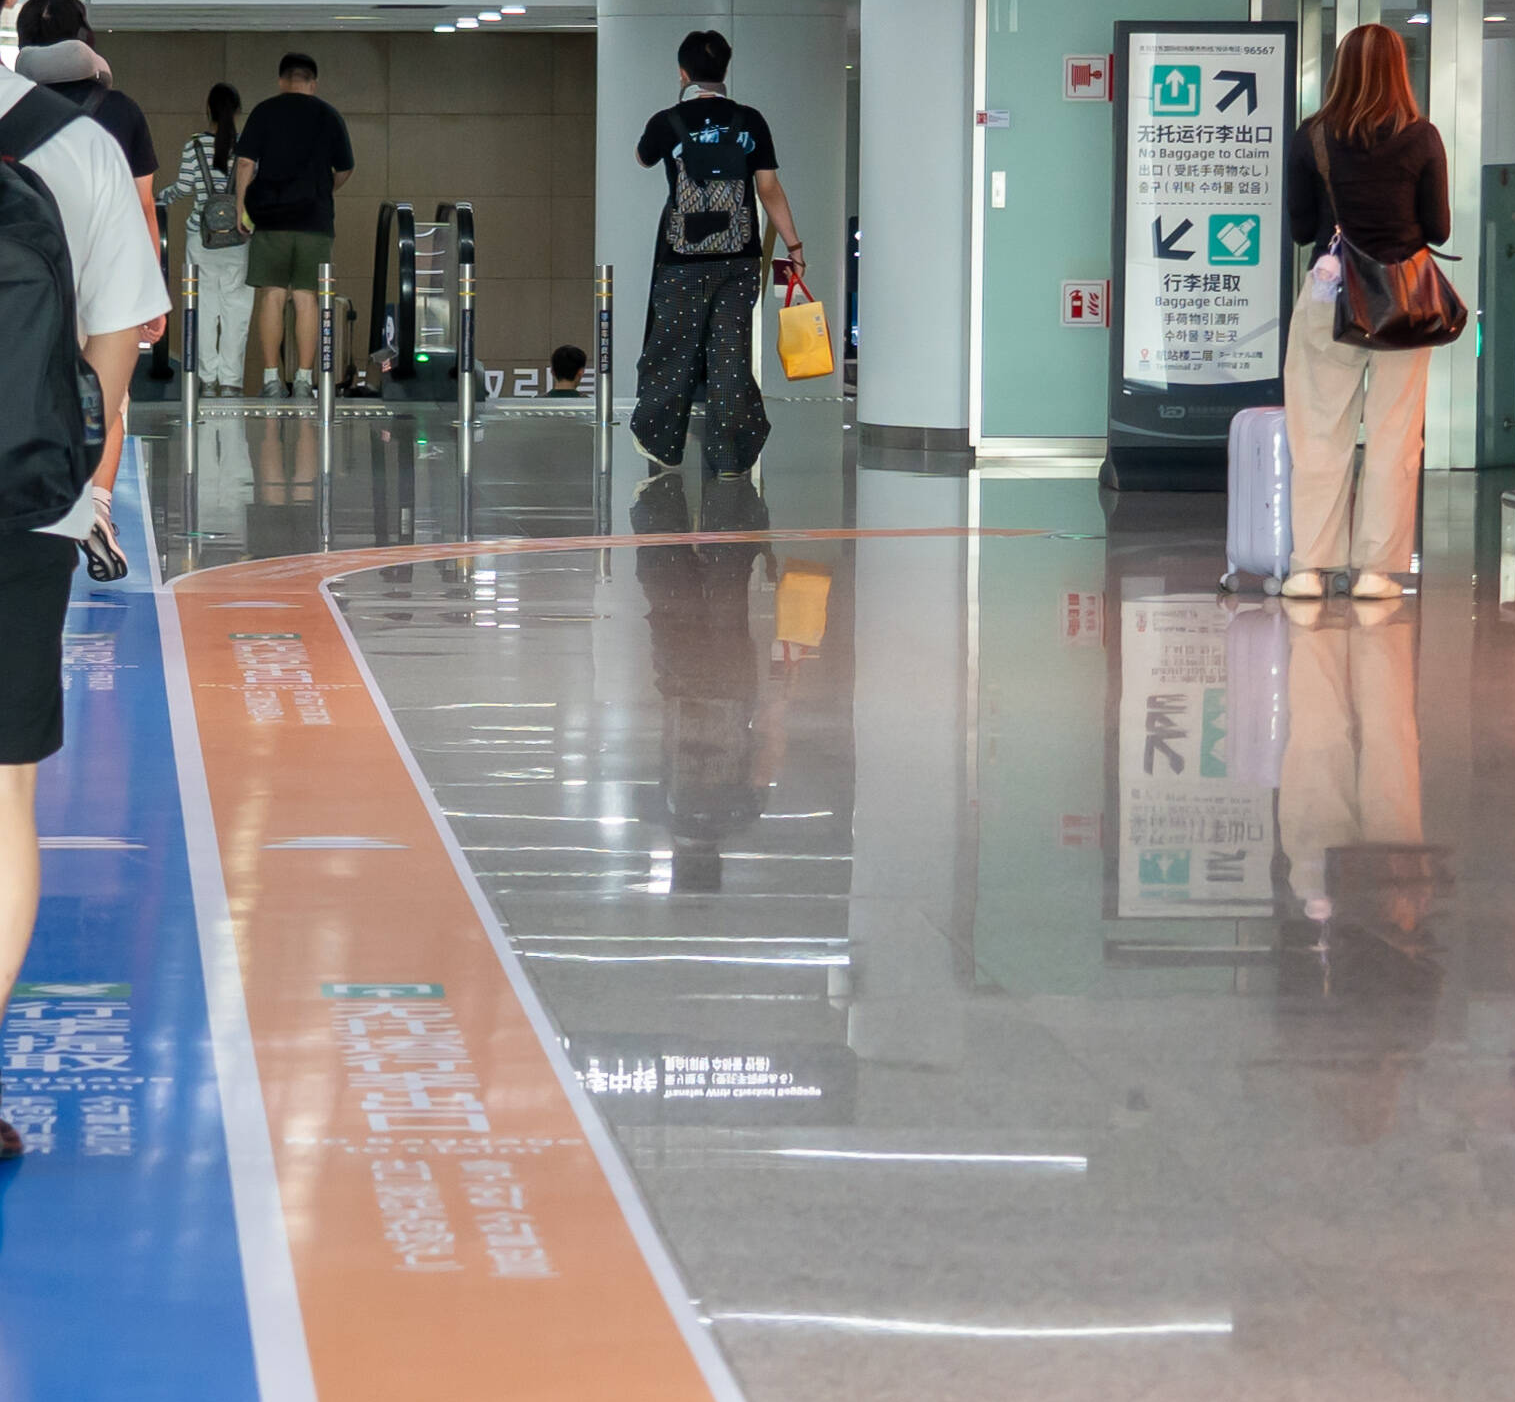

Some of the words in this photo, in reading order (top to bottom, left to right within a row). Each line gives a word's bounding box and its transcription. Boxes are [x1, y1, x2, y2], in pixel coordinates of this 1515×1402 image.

[1243, 46, 1275, 55] 96567
[1137, 124, 1273, 144] 无托运行李出口
[1138, 148, 1156, 158] No
[1159, 148, 1215, 161] Baggage
[1219, 149, 1231, 159] to
[1235, 148, 1269, 159] Claim
[1163, 273, 1241, 292] 行李提取
[1155, 297, 1210, 309] Baggage
[1214, 296, 1249, 307] Claim
[3, 1001, 132, 1072] 行李提取
